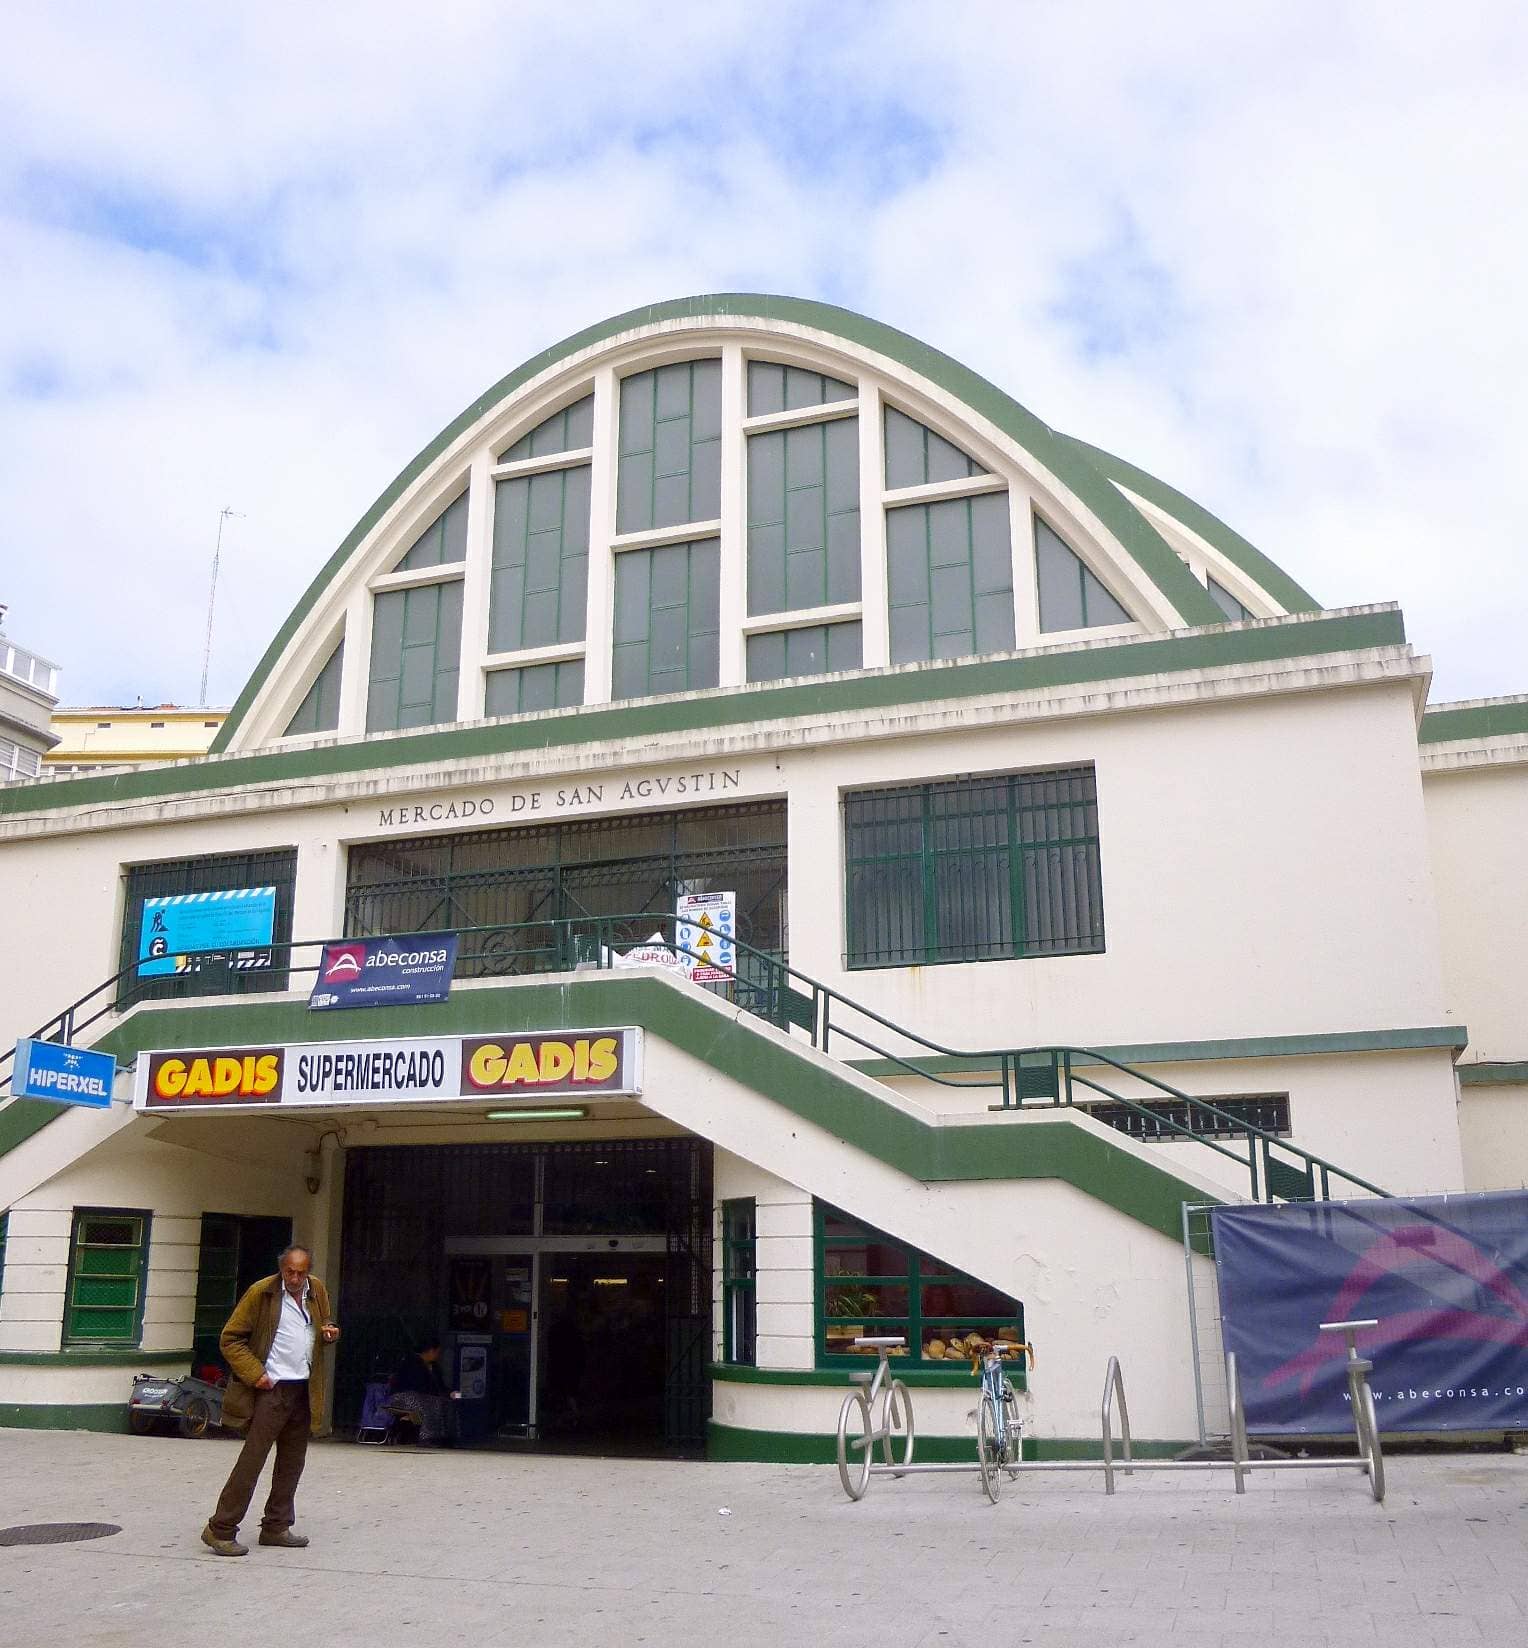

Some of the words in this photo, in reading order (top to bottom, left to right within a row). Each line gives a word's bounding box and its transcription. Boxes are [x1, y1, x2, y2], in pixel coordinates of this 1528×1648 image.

[379, 798, 495, 826] MERCADO
[511, 792, 542, 812] DE
[556, 785, 604, 807] SAN
[620, 770, 741, 800] AGVSTIN
[365, 949, 447, 967] abeconsa
[402, 964, 444, 974] construcción
[156, 1054, 279, 1099] GADIS
[298, 1049, 445, 1093] SUPERMERCADO
[469, 1037, 619, 1090] GADIS
[29, 1068, 108, 1097] HIPERXEL
[1343, 1386, 1524, 1400] ww.abeconsa.co
